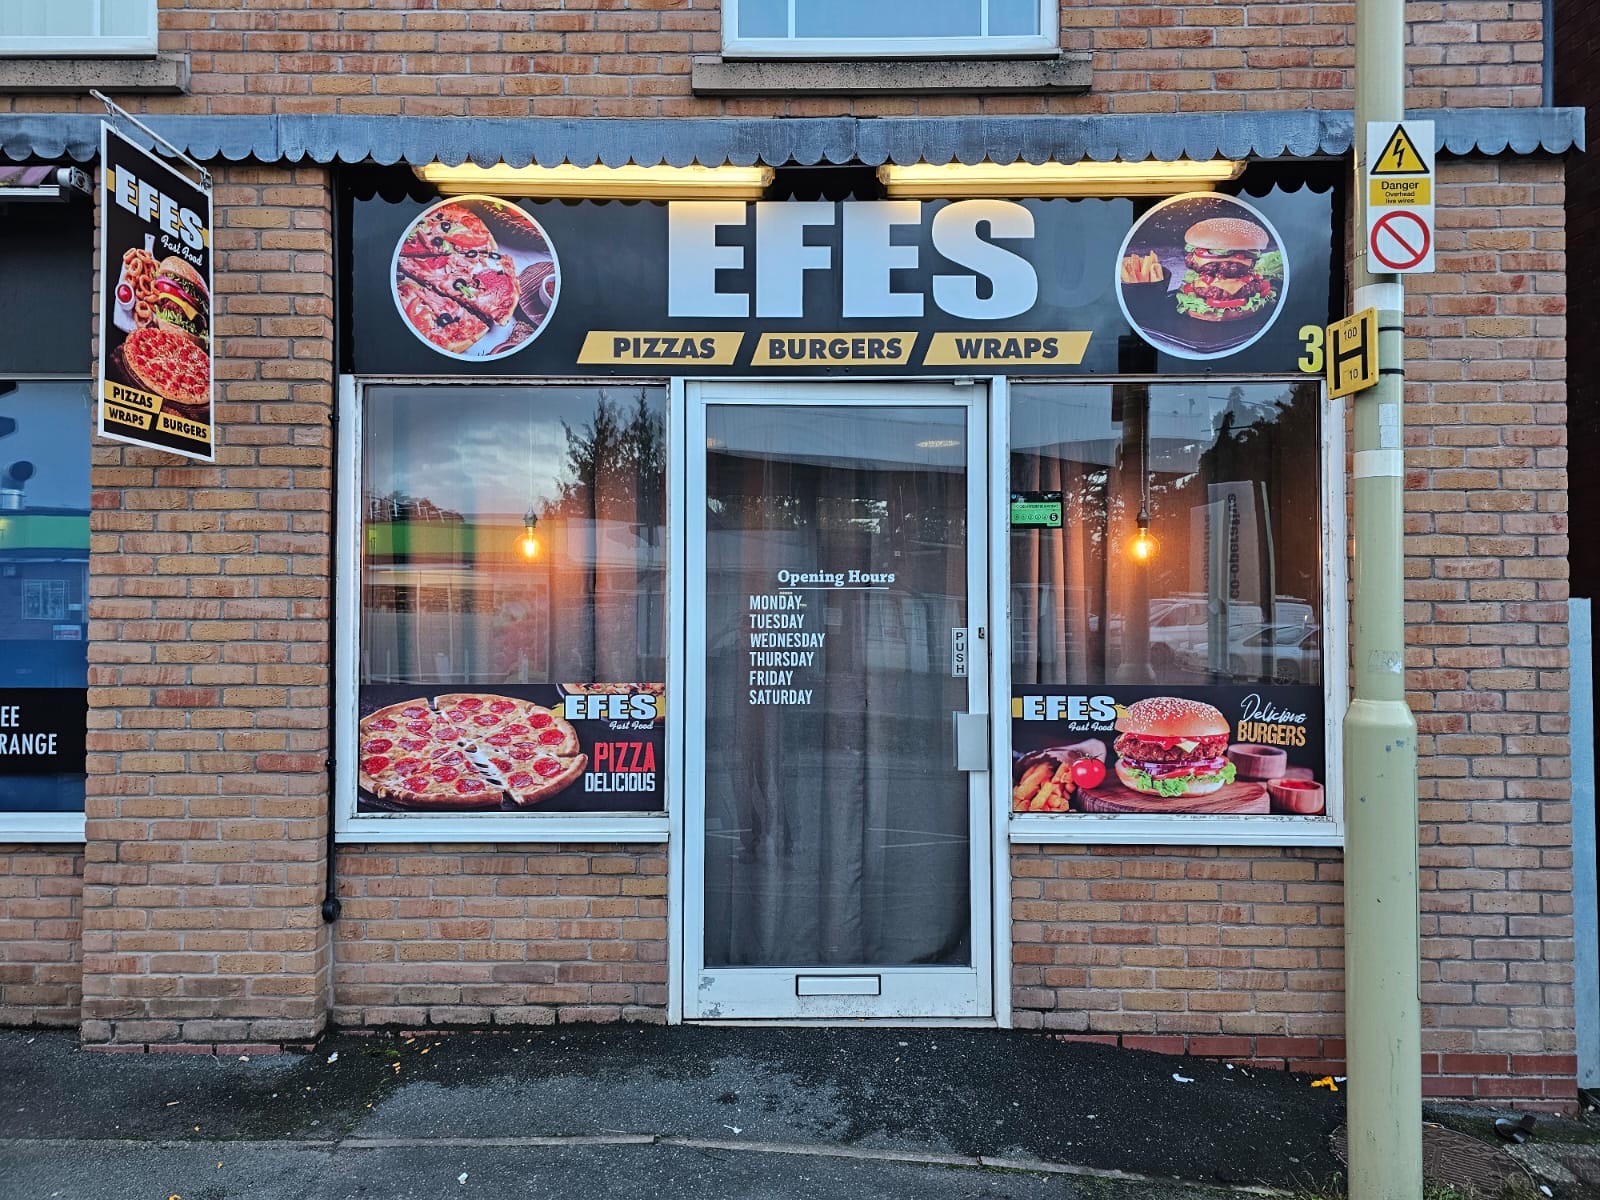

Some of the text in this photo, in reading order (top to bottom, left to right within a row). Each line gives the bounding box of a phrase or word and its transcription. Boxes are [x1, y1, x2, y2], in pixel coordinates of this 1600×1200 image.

[1381, 181, 1419, 191] Danger
[115, 163, 204, 251] EFES
[161, 235, 203, 267] Fast Food
[668, 199, 1038, 320] EFES
[1344, 327, 1357, 340] 100
[612, 337, 1059, 360] PIZZAS BURGERS WRAPS
[1298, 325, 1324, 373] 3
[1333, 317, 1368, 390] H
[1349, 369, 1358, 381] 10
[112, 386, 153, 409] PIZZAS
[108, 406, 144, 427] WRAPS
[162, 418, 207, 439] BURGERS
[778, 570, 895, 586] Opening Hours
[750, 595, 802, 610] MONDAY
[750, 614, 804, 629] TUESDAY
[750, 633, 825, 648] WEDNESDAY
[750, 652, 814, 667] THURSDAY
[955, 631, 965, 674] PUSH
[750, 671, 793, 686] FRIDAY
[565, 694, 657, 720] EFES
[750, 690, 812, 705] SATURDAY
[1023, 695, 1116, 721] EFES
[1239, 693, 1307, 724] Delicious
[609, 720, 653, 730] Fast Food
[1068, 721, 1114, 731] Fast Food
[1237, 722, 1306, 747] BURGERS
[594, 742, 656, 773] PIZZA
[584, 772, 656, 793] DELICIOUS
